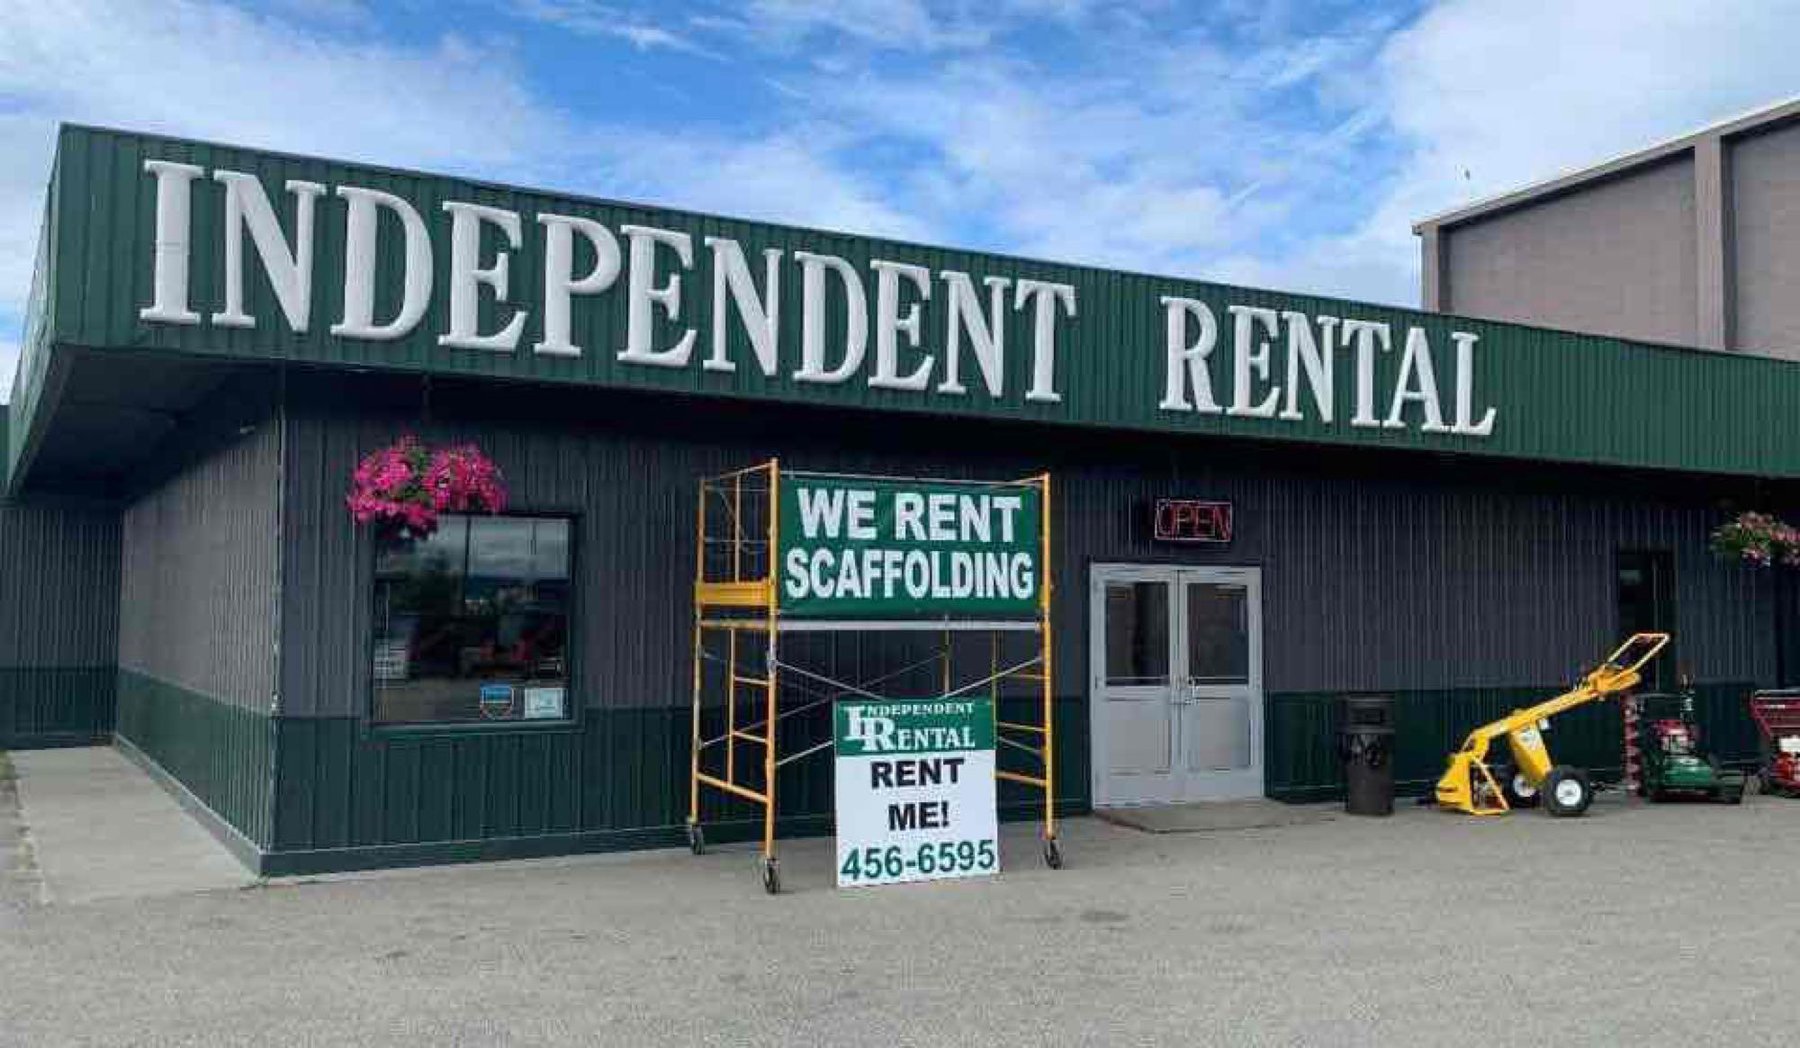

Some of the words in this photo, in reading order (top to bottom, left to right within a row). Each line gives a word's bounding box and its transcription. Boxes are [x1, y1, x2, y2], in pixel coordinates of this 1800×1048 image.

[139, 159, 1076, 402] INDEPENDENT
[1159, 295, 1496, 436] RENTAL
[797, 488, 877, 540] WE
[895, 492, 1021, 542] RENT
[1157, 504, 1230, 539] OPEN
[785, 547, 1034, 599] SCAFFOLDING
[843, 702, 974, 741] INDEPENDENT
[861, 716, 975, 751] RENTAL
[870, 758, 965, 789] RENT
[888, 801, 949, 831] ME!
[840, 839, 995, 880] 456-6595
